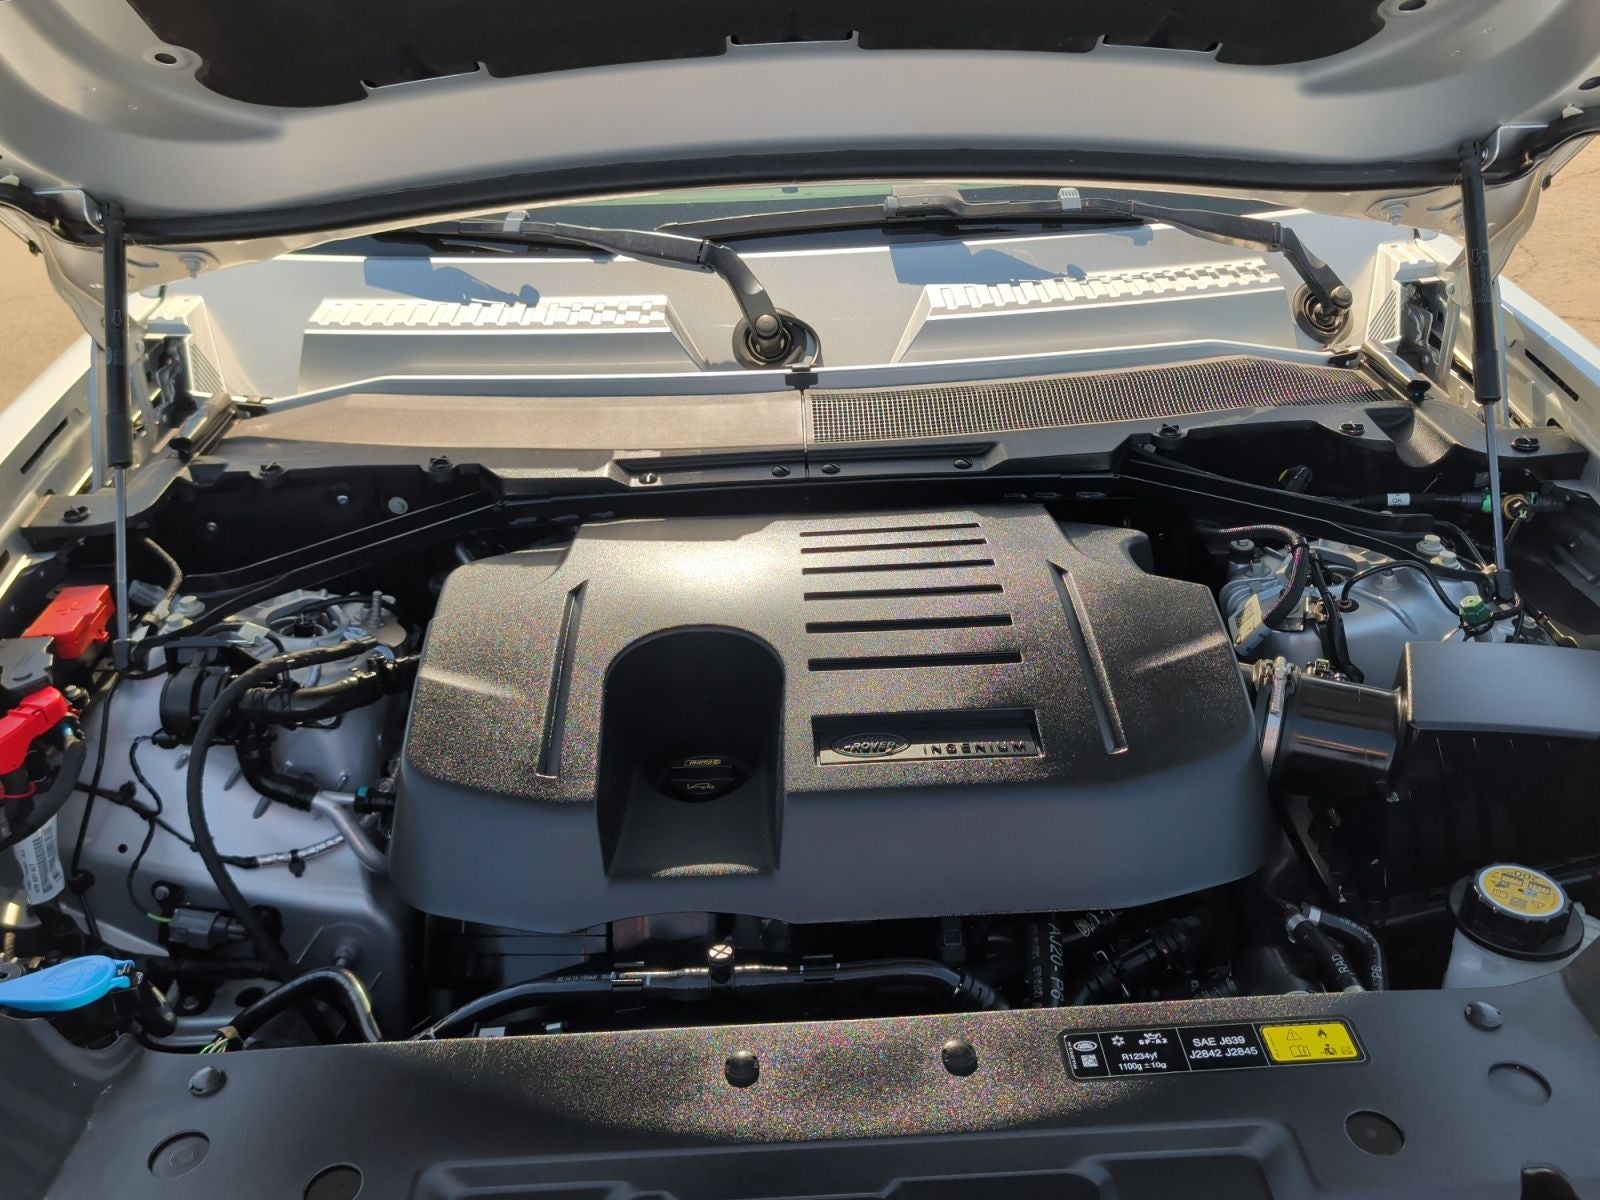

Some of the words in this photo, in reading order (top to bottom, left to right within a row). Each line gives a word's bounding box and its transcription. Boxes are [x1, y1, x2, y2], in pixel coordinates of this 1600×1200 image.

[923, 740, 1027, 755] INGENIUM
[1331, 953, 1351, 974] RAD
[1192, 1037, 1217, 1047] SAE
[1219, 1035, 1246, 1046] J639
[1121, 1051, 1158, 1061] R1234yf
[1189, 1049, 1223, 1059] J2842
[1225, 1046, 1258, 1057] J2845
[1118, 1062, 1143, 1071] 1100g
